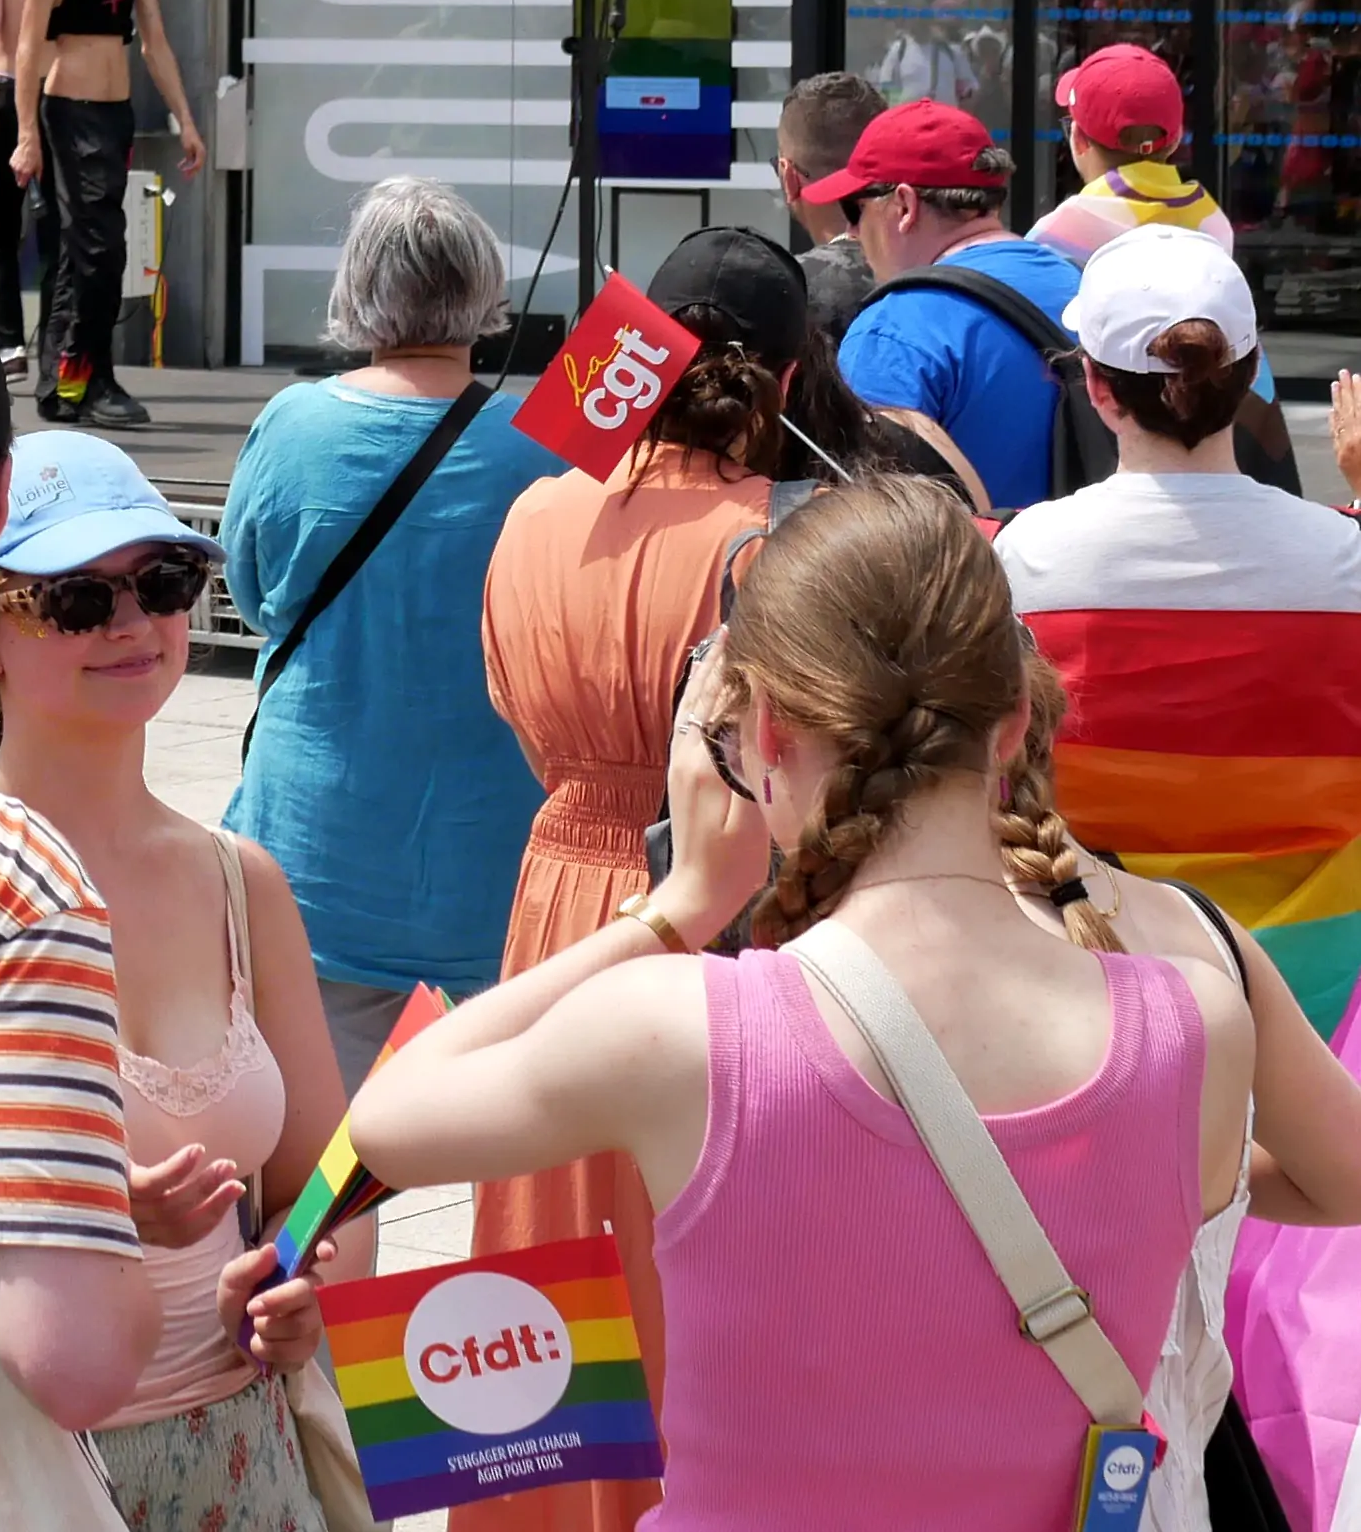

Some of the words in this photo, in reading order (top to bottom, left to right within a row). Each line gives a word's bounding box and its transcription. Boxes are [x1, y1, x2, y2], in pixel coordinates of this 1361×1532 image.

[583, 327, 670, 430] cgt
[17, 480, 67, 506] Löhne
[447, 1446, 507, 1473] S'ENGAGER
[506, 1438, 538, 1459] POUR
[538, 1431, 582, 1452] CHACUN
[477, 1466, 503, 1485] AGIR
[503, 1459, 535, 1479] POUR
[536, 1453, 563, 1472] TOUS
